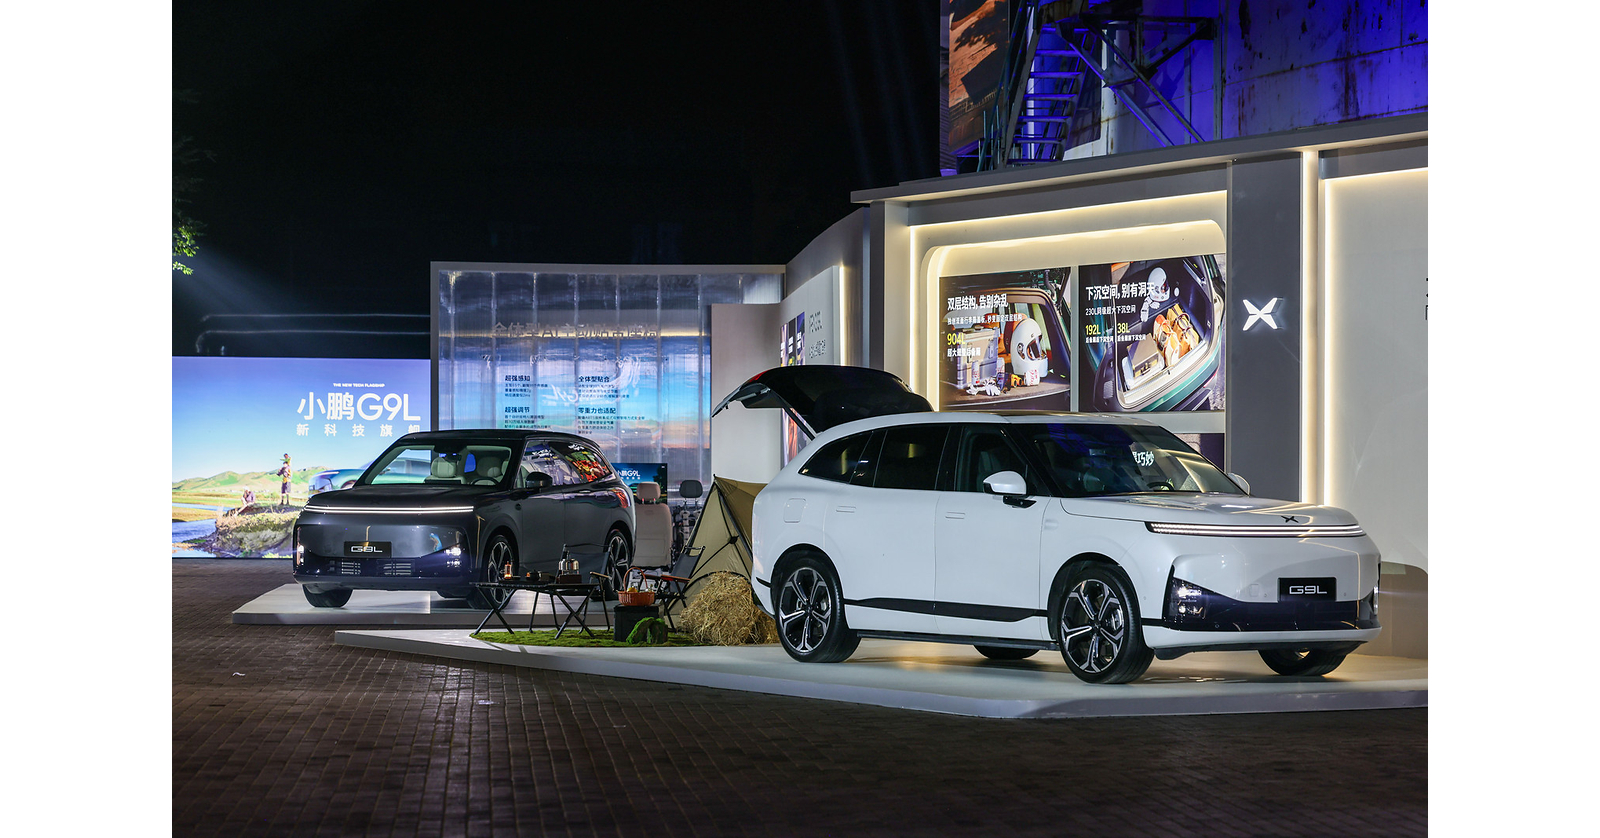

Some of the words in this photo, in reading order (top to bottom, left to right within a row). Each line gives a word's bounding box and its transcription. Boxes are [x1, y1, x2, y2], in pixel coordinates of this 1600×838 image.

[1085, 324, 1101, 336] 192L
[1117, 322, 1131, 334] 38L
[947, 332, 966, 346] 904L
[297, 391, 421, 421] 小鹏G9L
[1289, 585, 1328, 595] G9L
